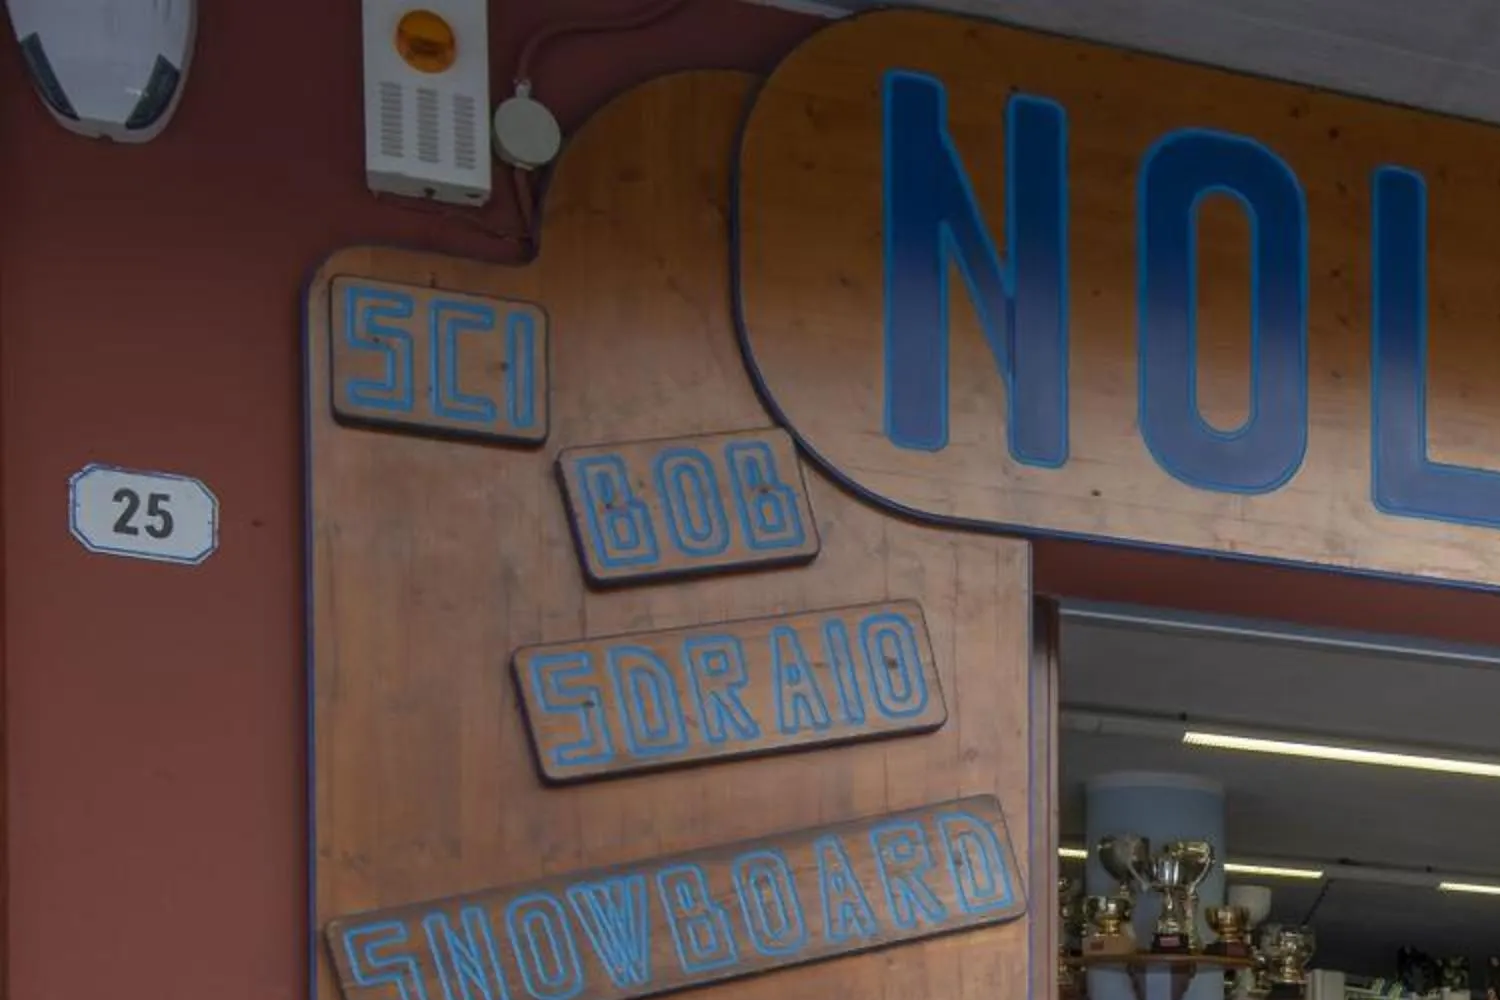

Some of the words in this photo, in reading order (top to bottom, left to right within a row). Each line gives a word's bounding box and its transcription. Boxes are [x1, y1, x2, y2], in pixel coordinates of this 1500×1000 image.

[344, 286, 535, 428] SCI
[112, 488, 173, 538] 25
[578, 440, 806, 567] BOB
[529, 613, 928, 767] SDRAIO
